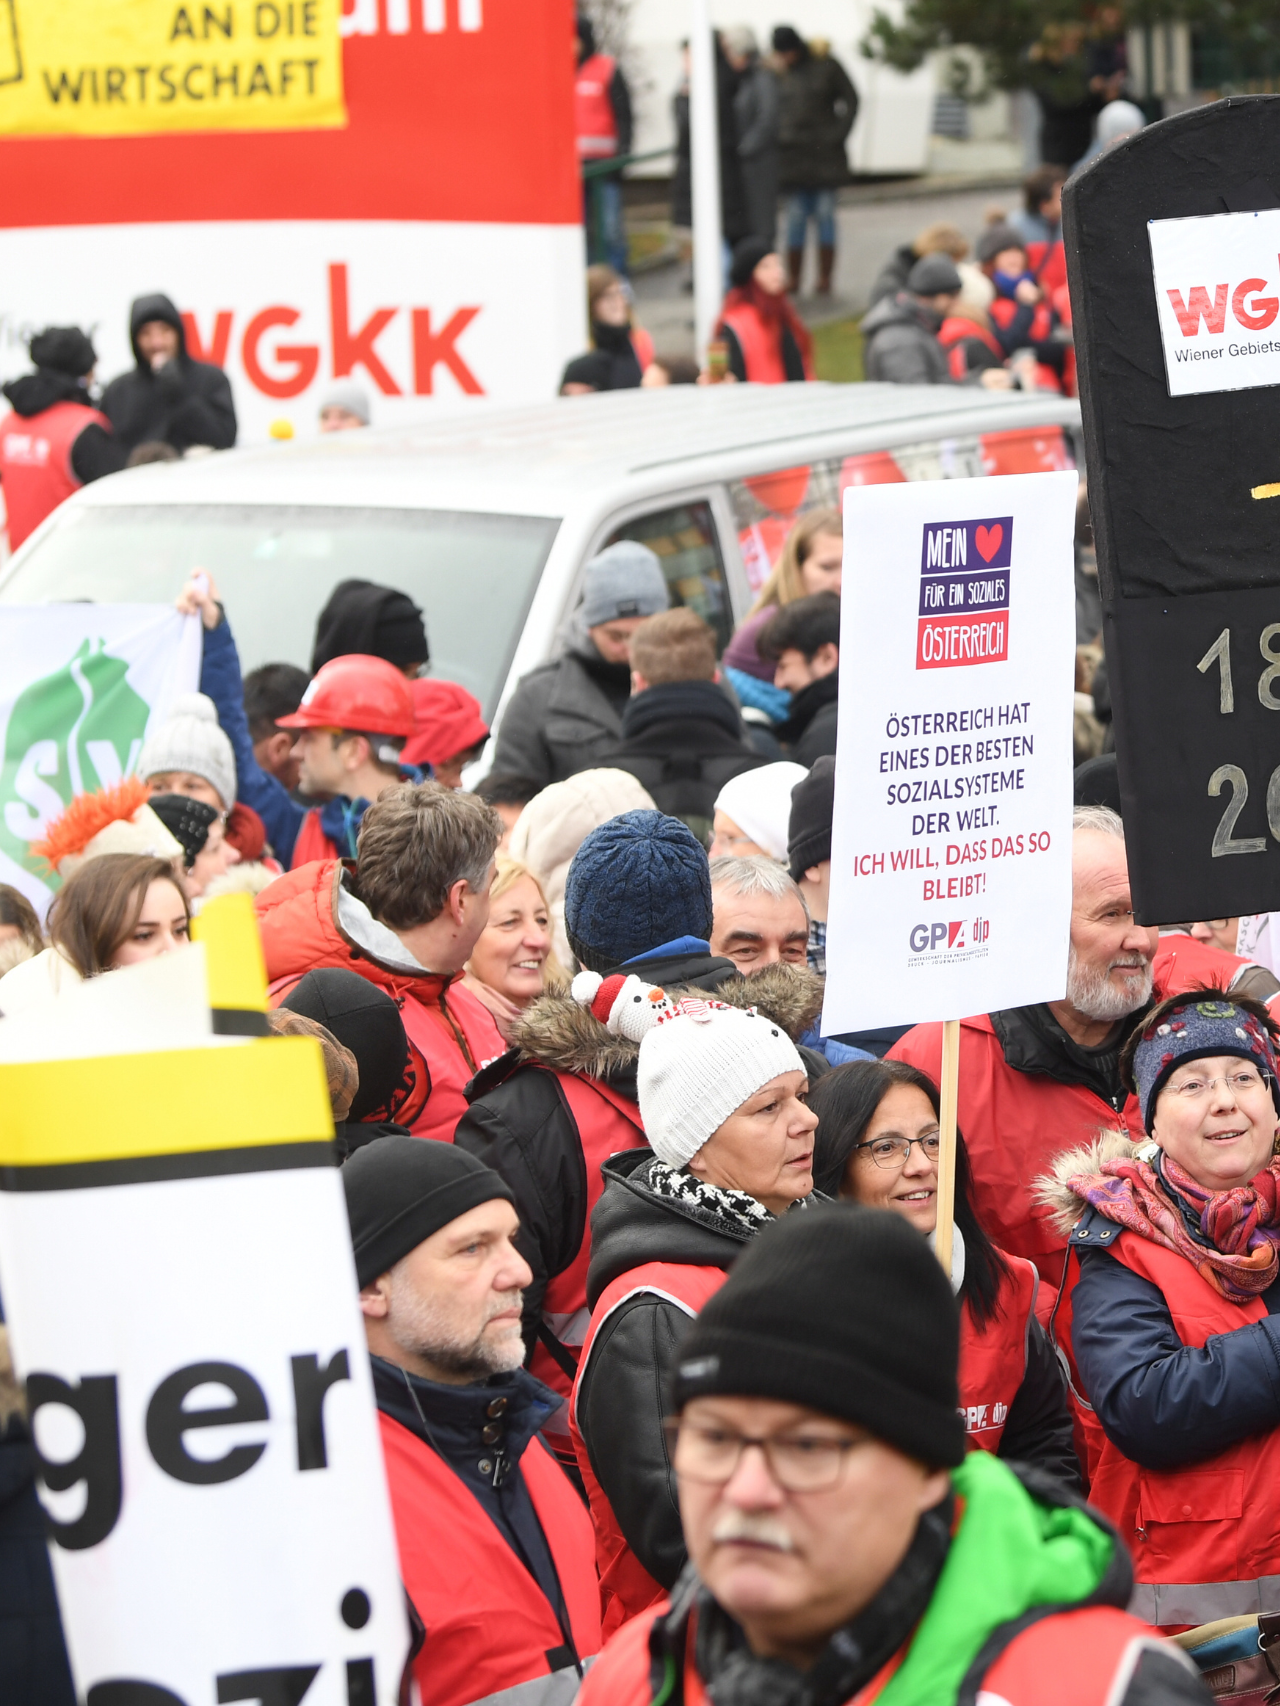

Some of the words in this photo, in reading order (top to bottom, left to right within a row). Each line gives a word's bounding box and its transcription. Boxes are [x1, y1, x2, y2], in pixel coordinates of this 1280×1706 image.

[169, 5, 233, 41] AN
[254, 2, 318, 38] DIE
[42, 59, 321, 105] WIRTSCHAFT
[1175, 346, 1225, 363] Wiener
[927, 527, 967, 569] MEIN
[924, 582, 945, 608] FÜR
[948, 583, 964, 606] EIN
[968, 578, 1006, 605] SOZIALES
[922, 621, 1005, 662] ÖSTERREICH
[886, 706, 994, 739] ÖSTERREICH
[998, 702, 1031, 726] HAT
[879, 747, 930, 773] EINES
[935, 743, 973, 767] DER
[976, 734, 1034, 763] BESTEN
[886, 768, 1026, 806] SOZIALSYSTEME
[912, 812, 951, 836] DER
[956, 804, 1000, 832] WELT.
[854, 852, 885, 877] ICH
[890, 846, 939, 871] WILL,
[945, 839, 987, 866] DASS
[991, 834, 1025, 859] DAS
[1028, 830, 1051, 854] SO
[923, 872, 987, 901] BLEIBT!
[909, 920, 967, 953] GPA
[973, 916, 990, 944] djp
[26, 1346, 351, 1551] ger
